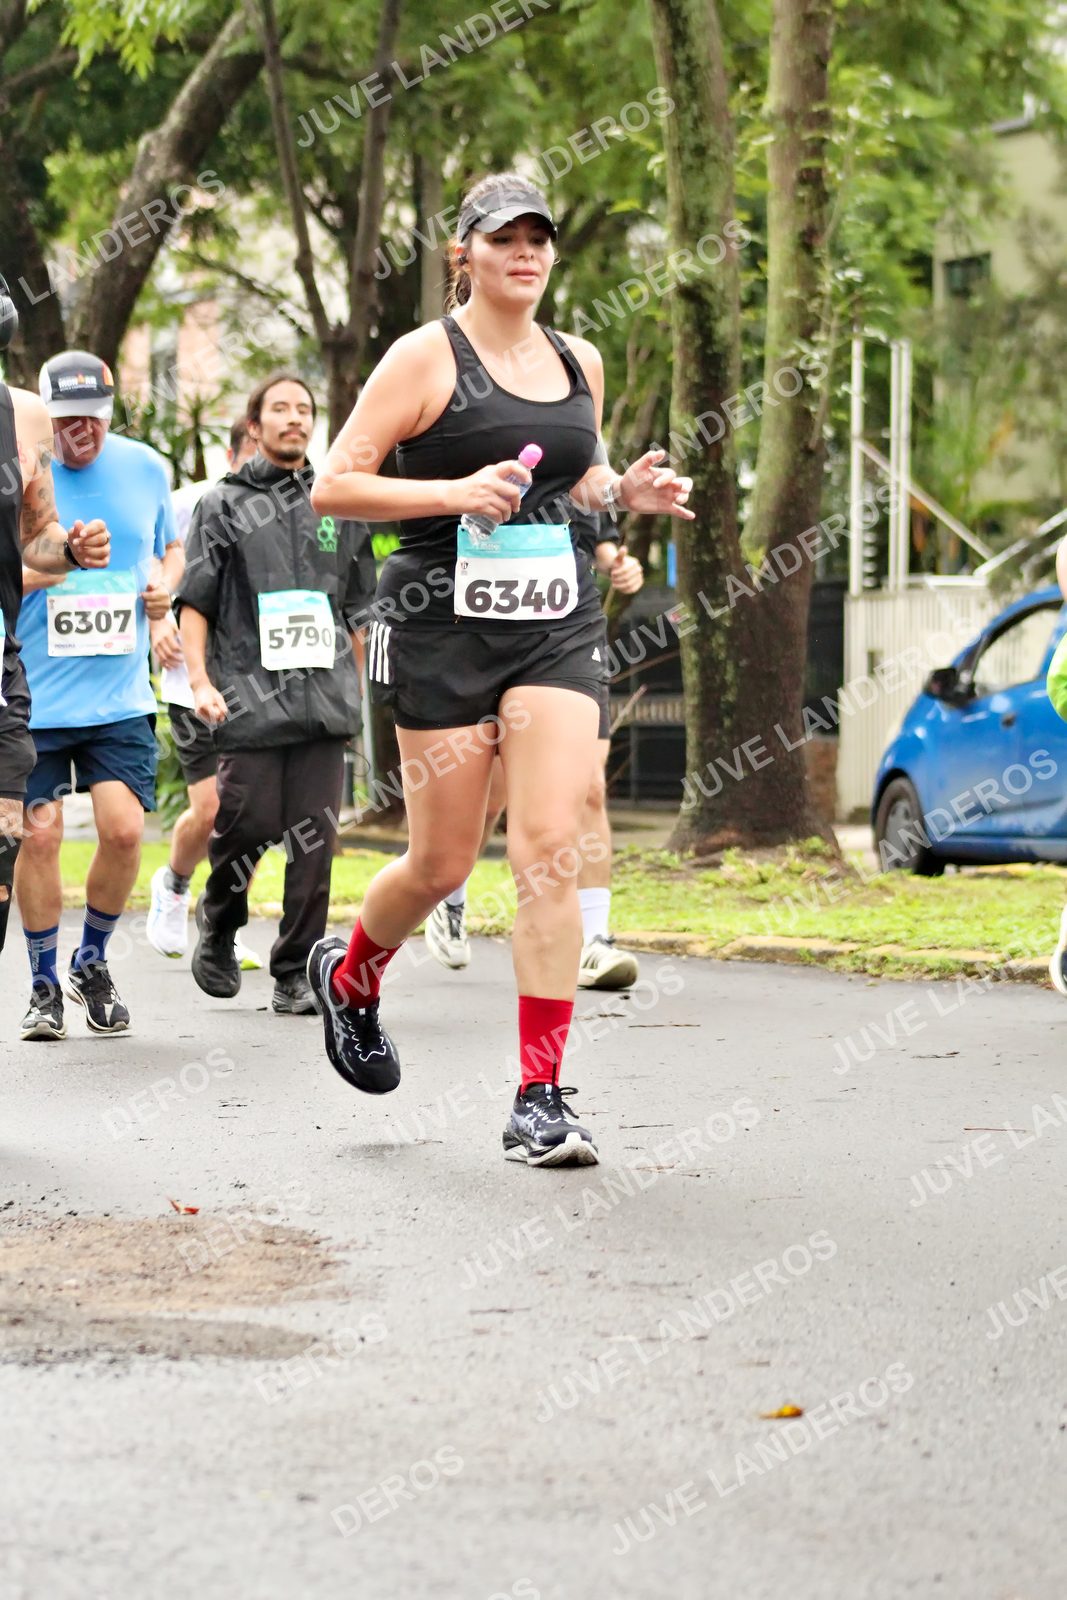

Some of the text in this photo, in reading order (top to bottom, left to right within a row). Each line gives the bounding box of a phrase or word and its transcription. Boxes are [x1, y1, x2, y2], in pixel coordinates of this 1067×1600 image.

[464, 578, 570, 614] 6340
[54, 609, 132, 635] 6307
[268, 626, 332, 650] 5790
